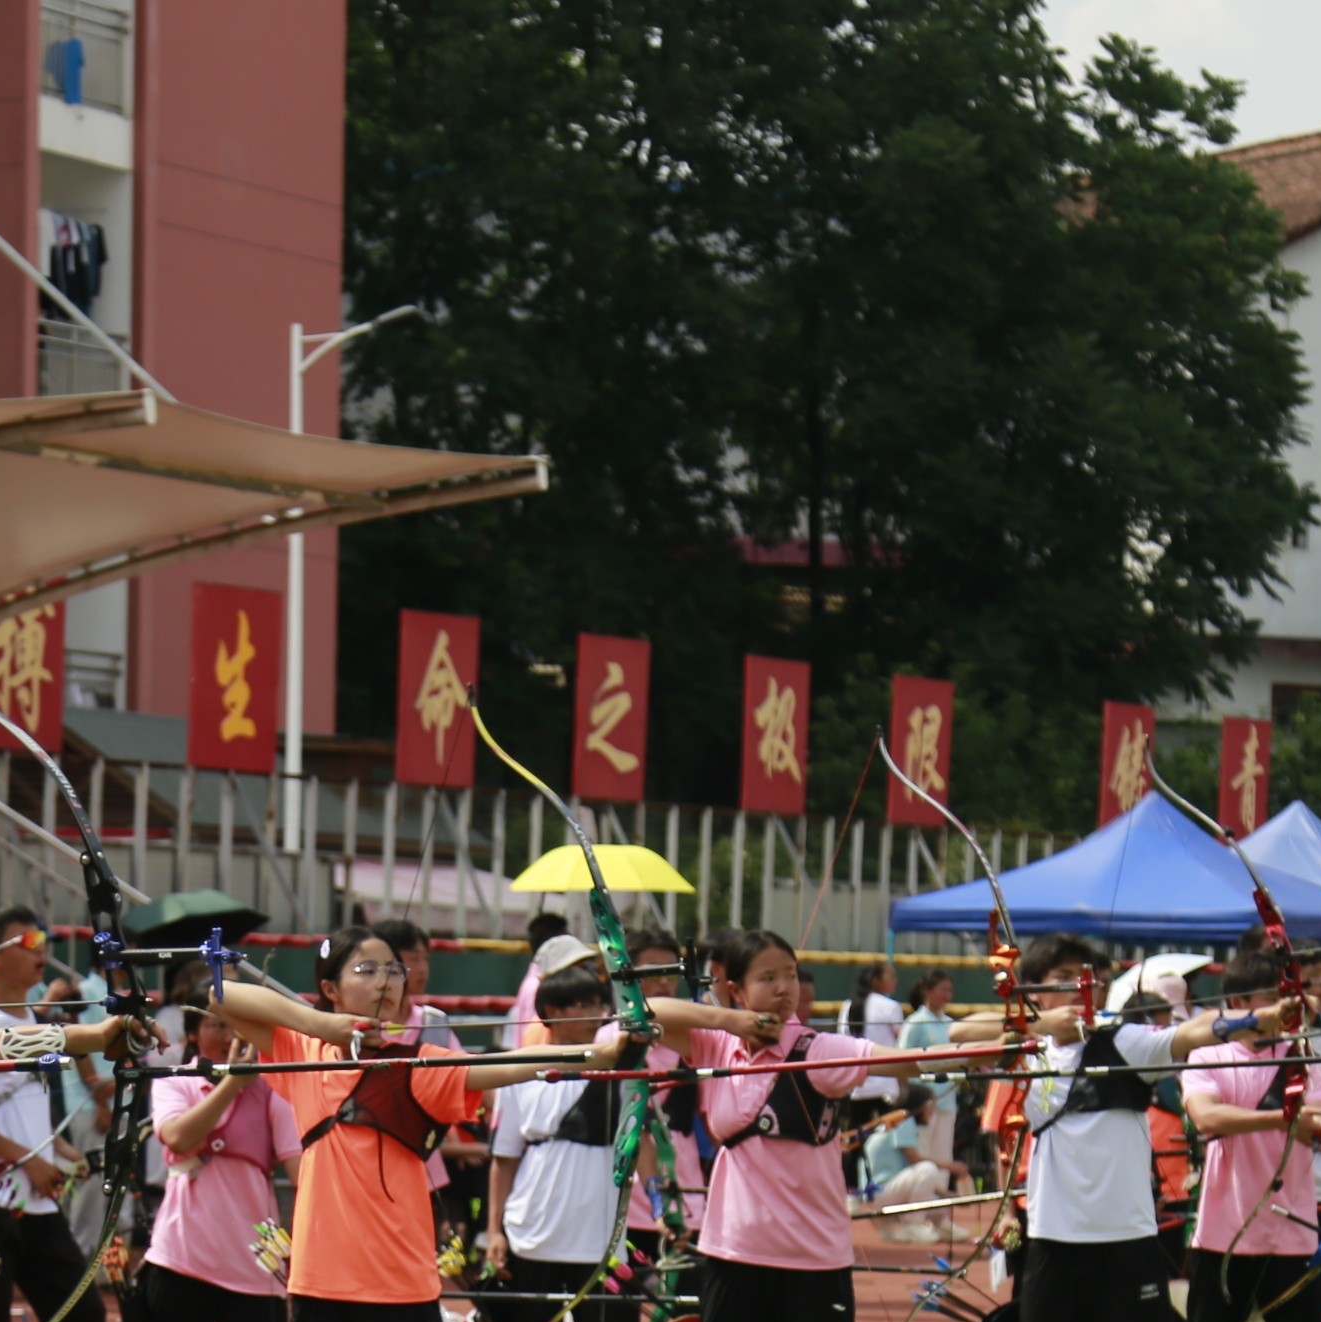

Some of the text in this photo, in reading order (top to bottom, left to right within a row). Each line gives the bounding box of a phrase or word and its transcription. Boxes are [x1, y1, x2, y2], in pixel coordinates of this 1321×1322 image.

[215, 608, 257, 743] 生
[414, 628, 468, 766] 命
[586, 661, 640, 773] 之
[1230, 723, 1265, 833] 青
